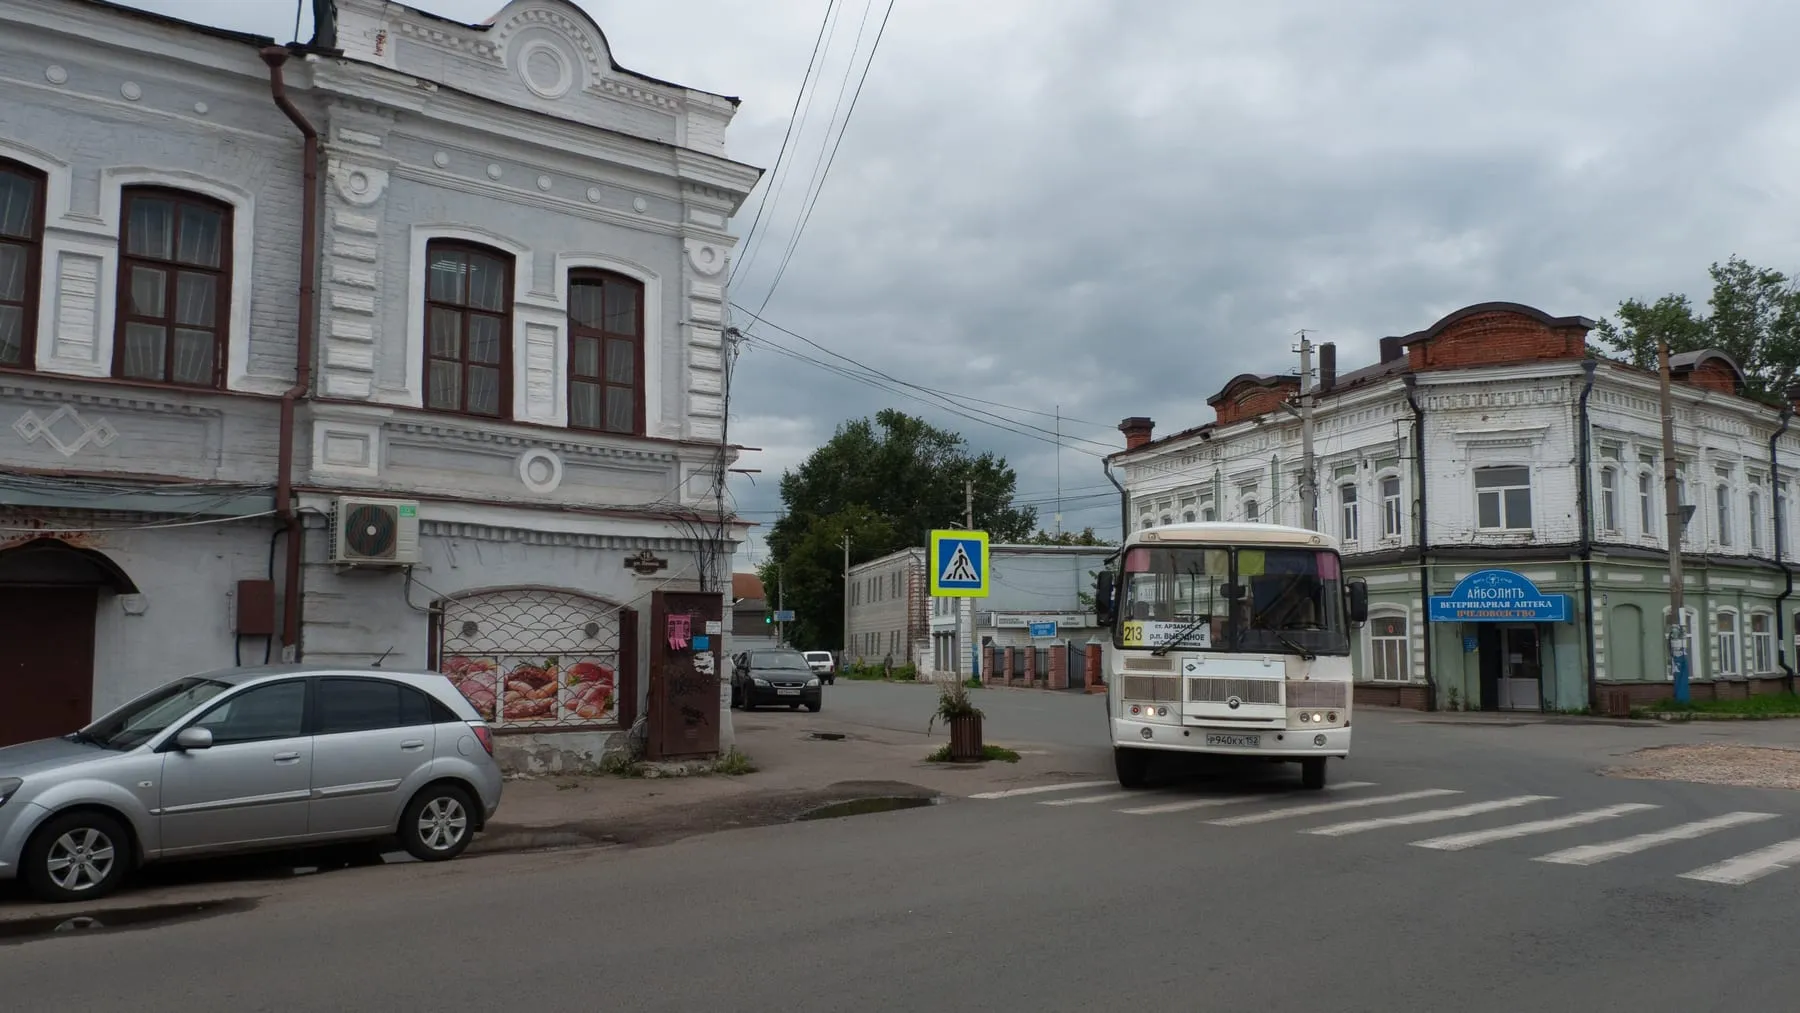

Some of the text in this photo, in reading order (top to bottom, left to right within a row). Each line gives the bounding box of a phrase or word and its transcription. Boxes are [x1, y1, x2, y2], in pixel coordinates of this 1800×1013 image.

[1467, 586, 1525, 599] АЙБОЛИТЪ
[1440, 600, 1552, 609] ВЕТЕРИНАРНАЯ АПТЕКА
[1124, 626, 1143, 641] 213
